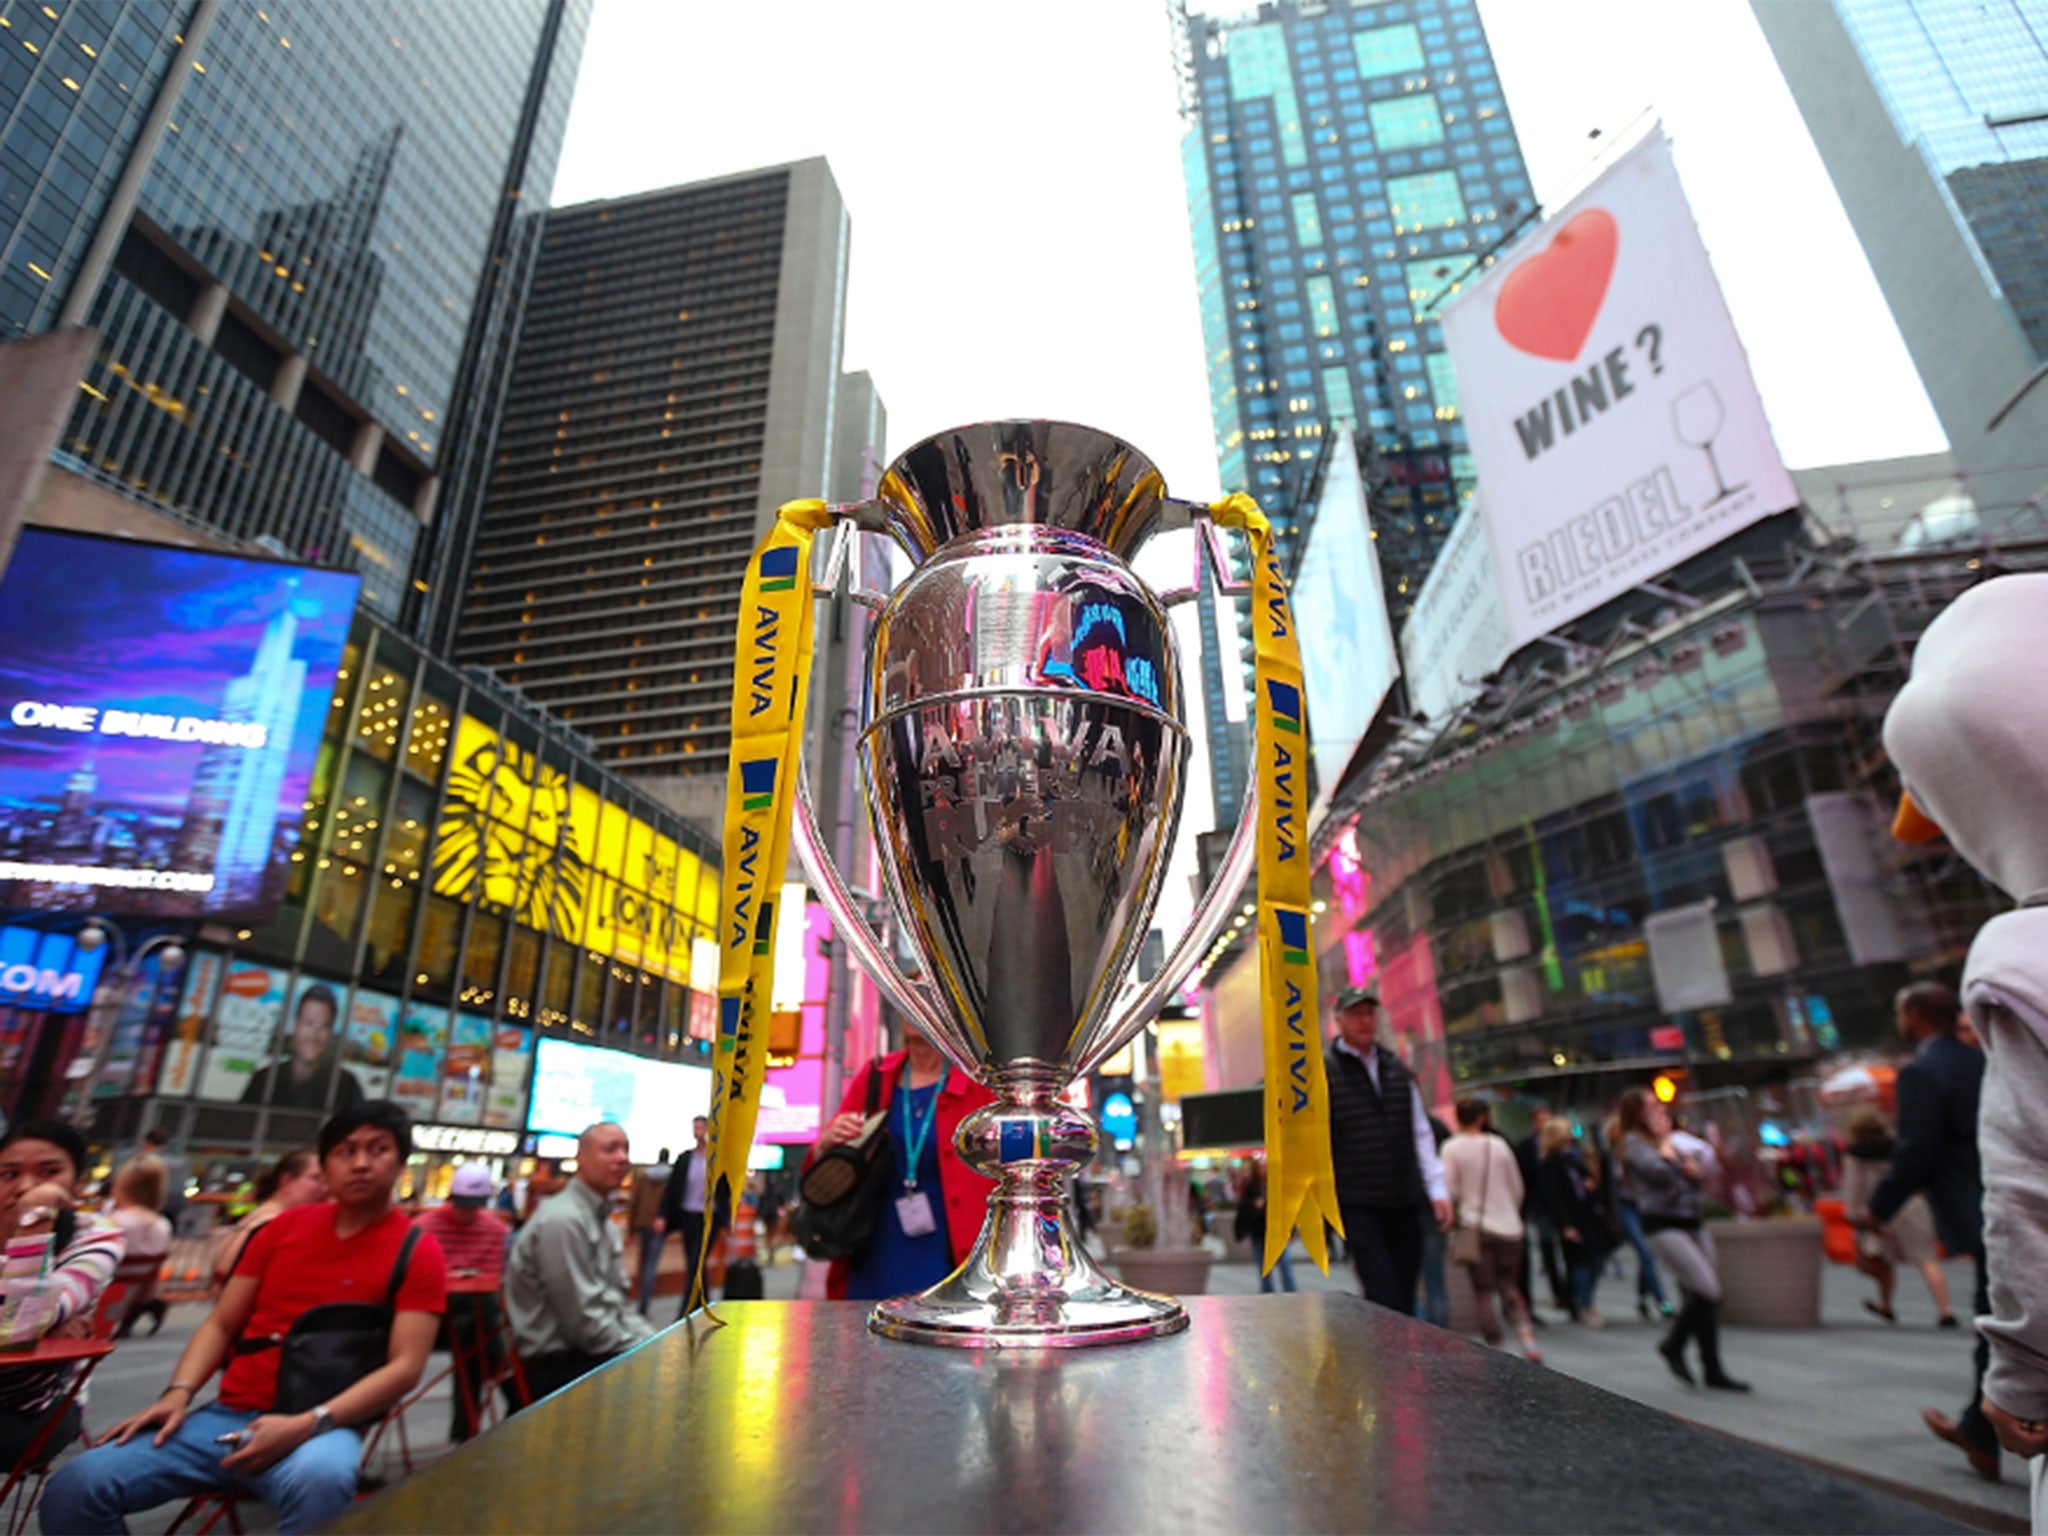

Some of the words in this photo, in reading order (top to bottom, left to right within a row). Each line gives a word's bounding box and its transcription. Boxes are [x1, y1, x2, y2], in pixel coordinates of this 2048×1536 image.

[1514, 345, 1634, 461] WINE
[1518, 463, 1692, 606] RIEDEL
[1566, 576, 1602, 603] WINE
[1667, 493, 1757, 547] COMPANY
[750, 605, 779, 718] AVIVA
[11, 701, 98, 731] ONE
[100, 709, 267, 748] BUILDING
[920, 716, 1131, 778] AVIVA
[1273, 742, 1297, 862] AVIVA
[730, 825, 759, 949] AVIVA
[1284, 979, 1311, 1115] AVIVA
